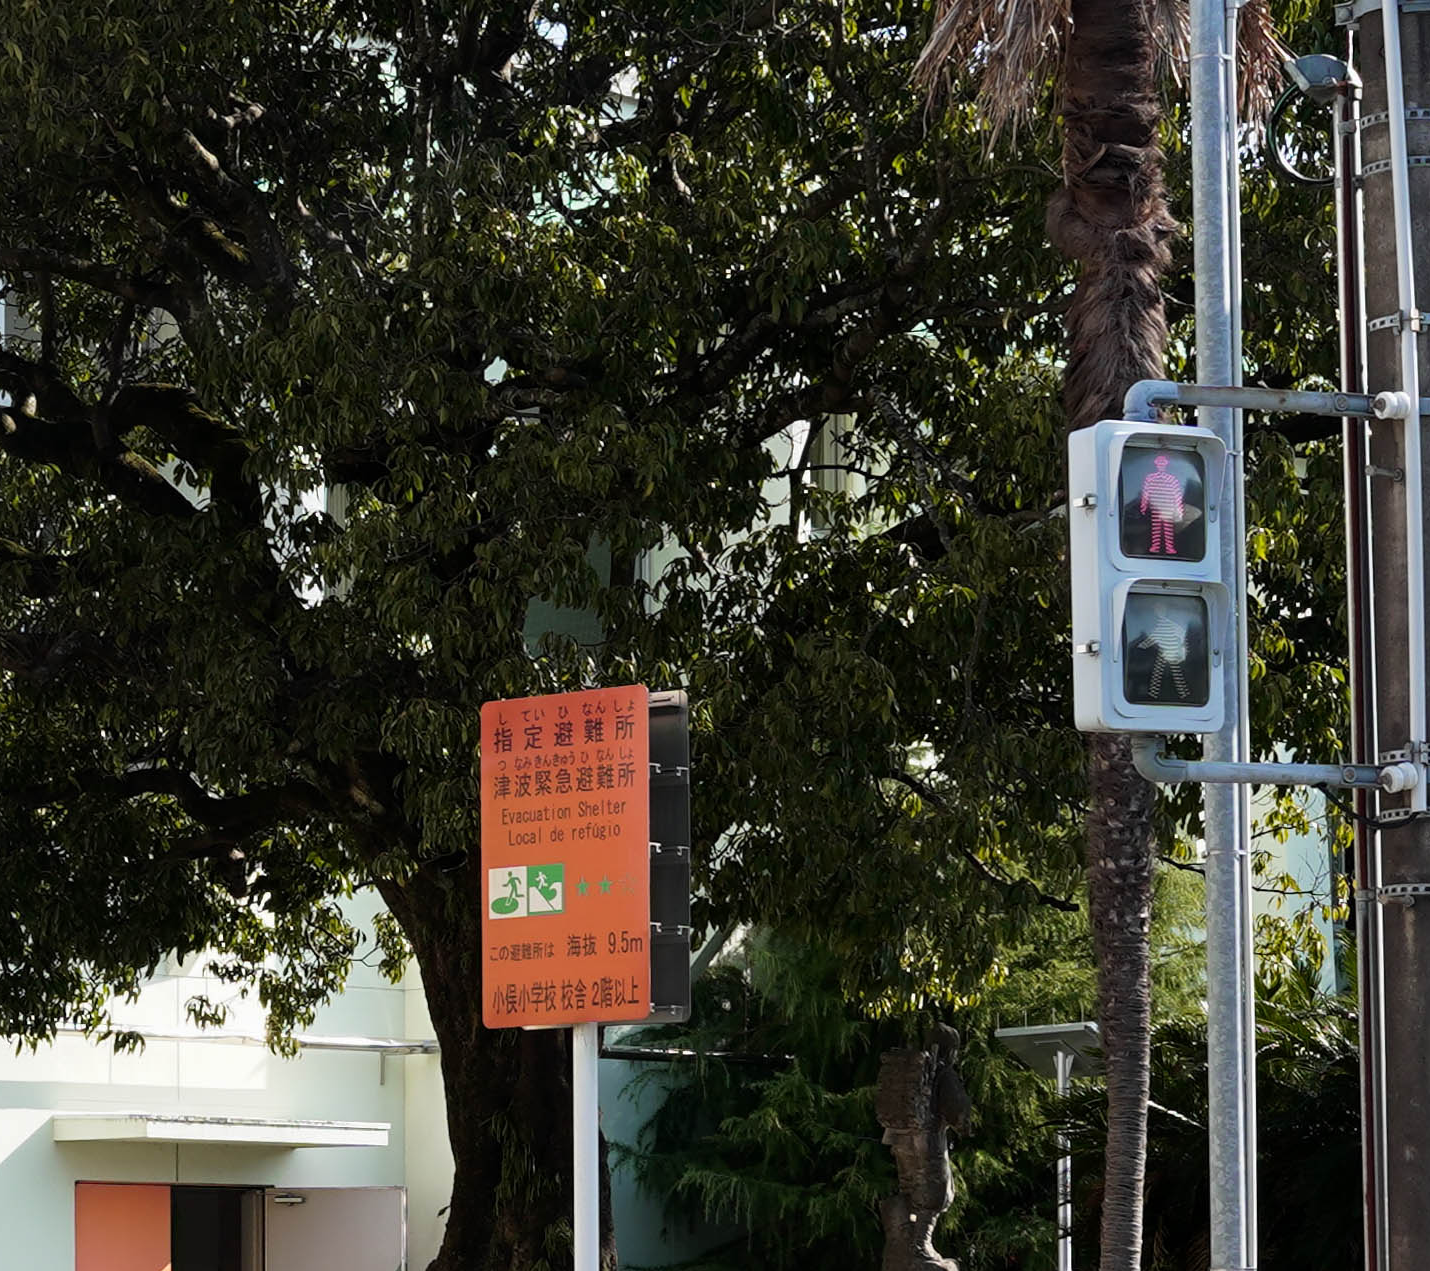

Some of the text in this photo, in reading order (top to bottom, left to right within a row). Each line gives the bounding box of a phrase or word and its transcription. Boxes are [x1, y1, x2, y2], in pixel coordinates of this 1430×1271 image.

[493, 713, 635, 754] 指定避難所
[493, 761, 637, 801] 津波緊急避難所
[501, 799, 627, 826] Evacuation Shelter
[507, 820, 622, 847] Local de refúgio
[489, 930, 643, 962] この避難所は 海抜 9.5m
[491, 975, 641, 1015] 小俣小学校 校舎 2階以上
